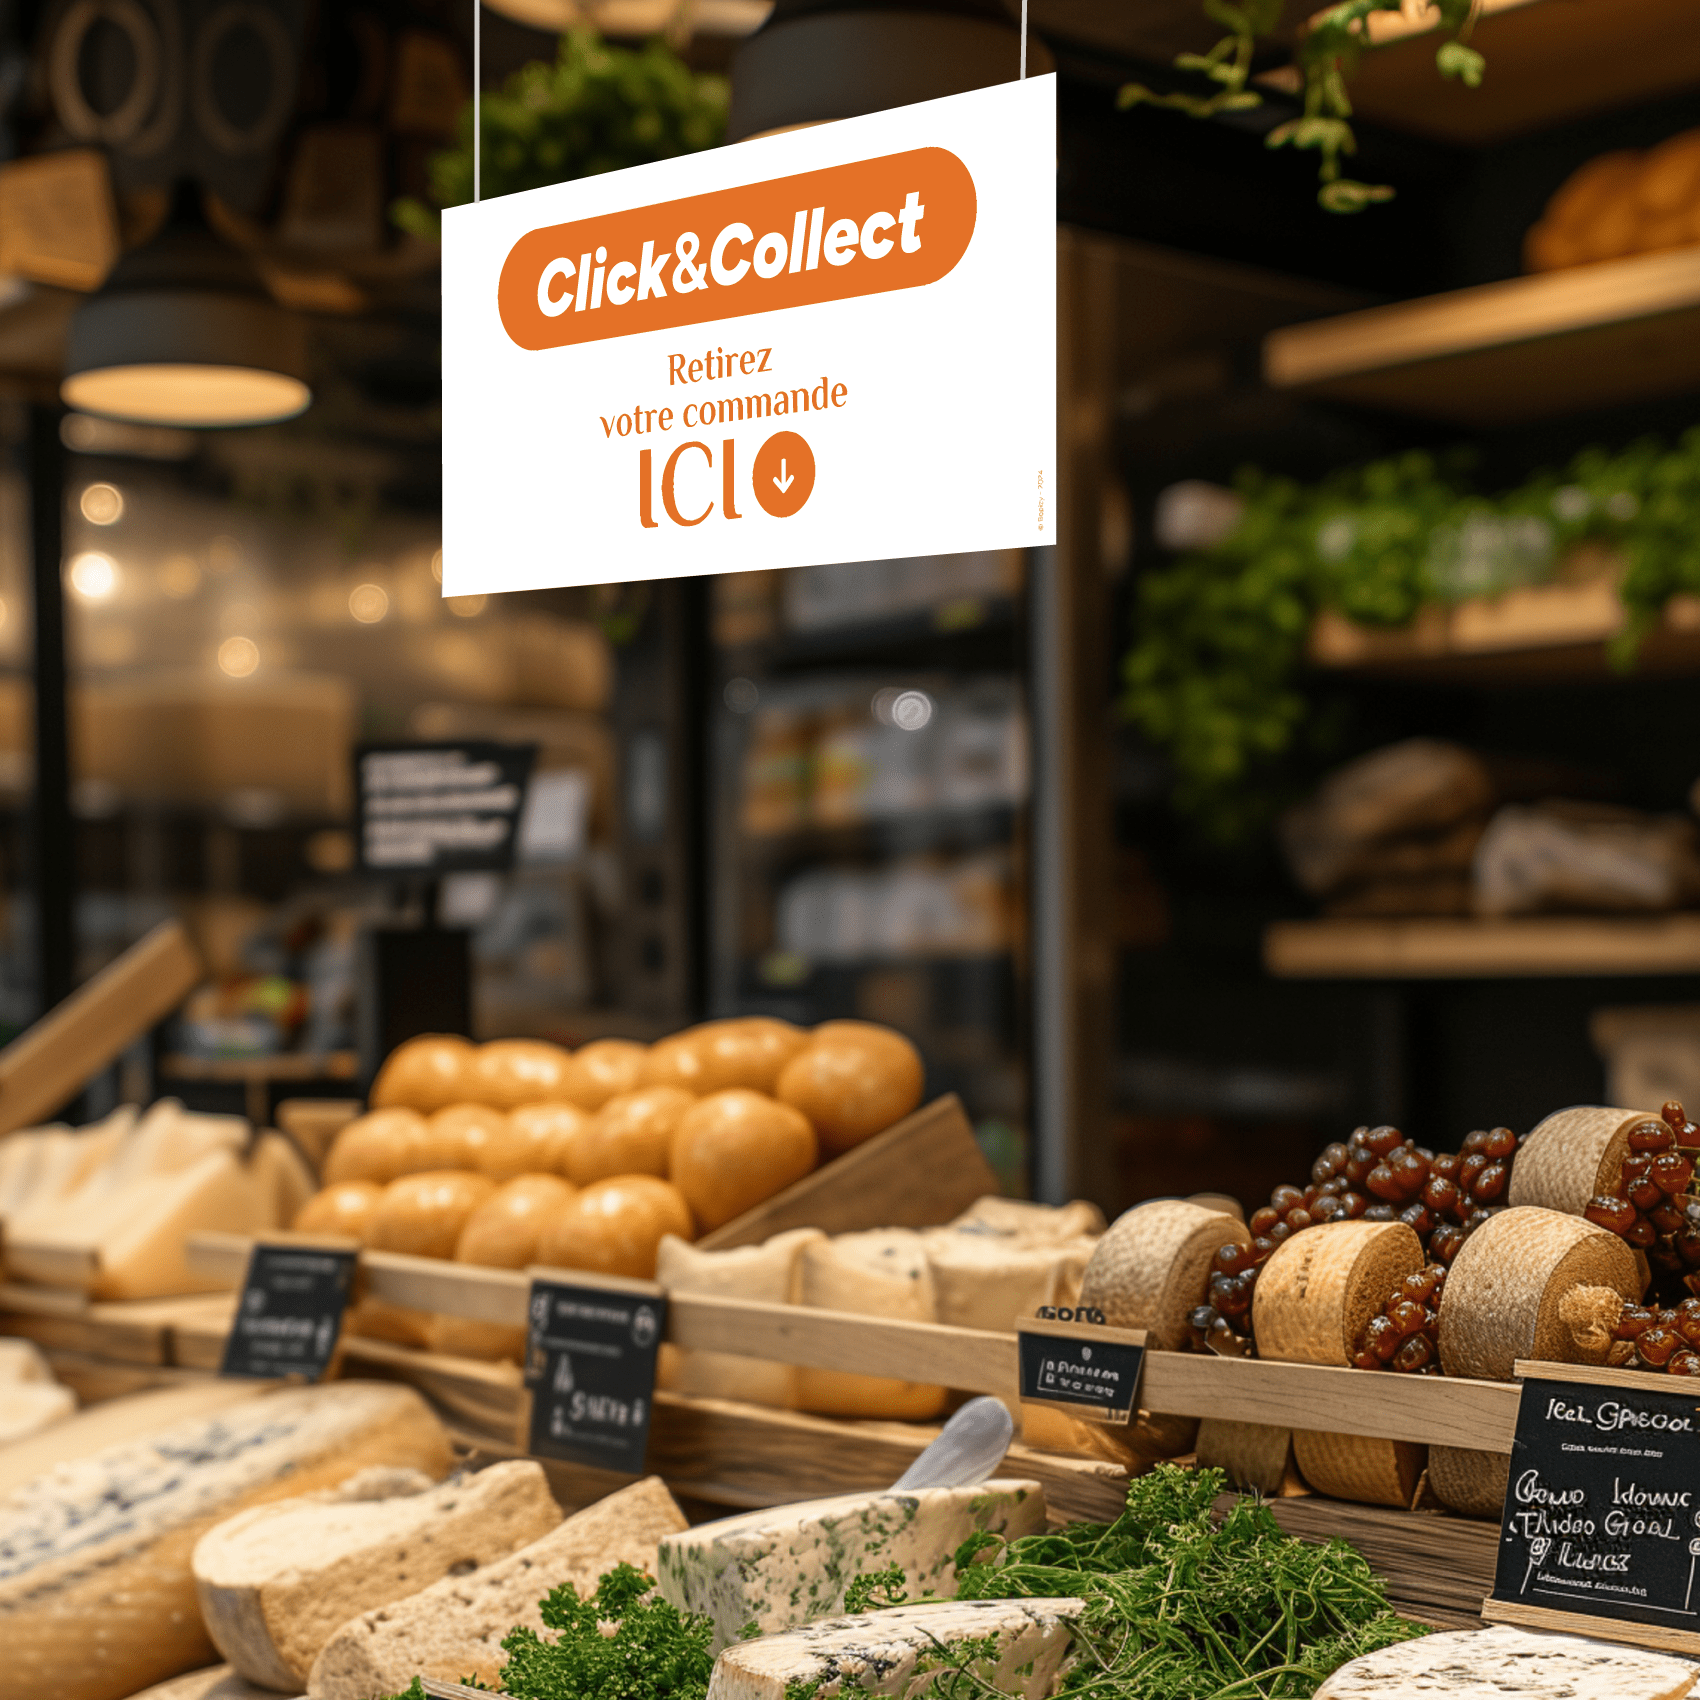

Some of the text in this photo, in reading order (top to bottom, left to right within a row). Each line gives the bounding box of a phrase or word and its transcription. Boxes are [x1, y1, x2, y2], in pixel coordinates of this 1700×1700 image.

[537, 191, 925, 318] Click&Collect
[667, 347, 773, 386] Retirez
[600, 376, 849, 439] votre commande
[639, 438, 743, 529] ICI
